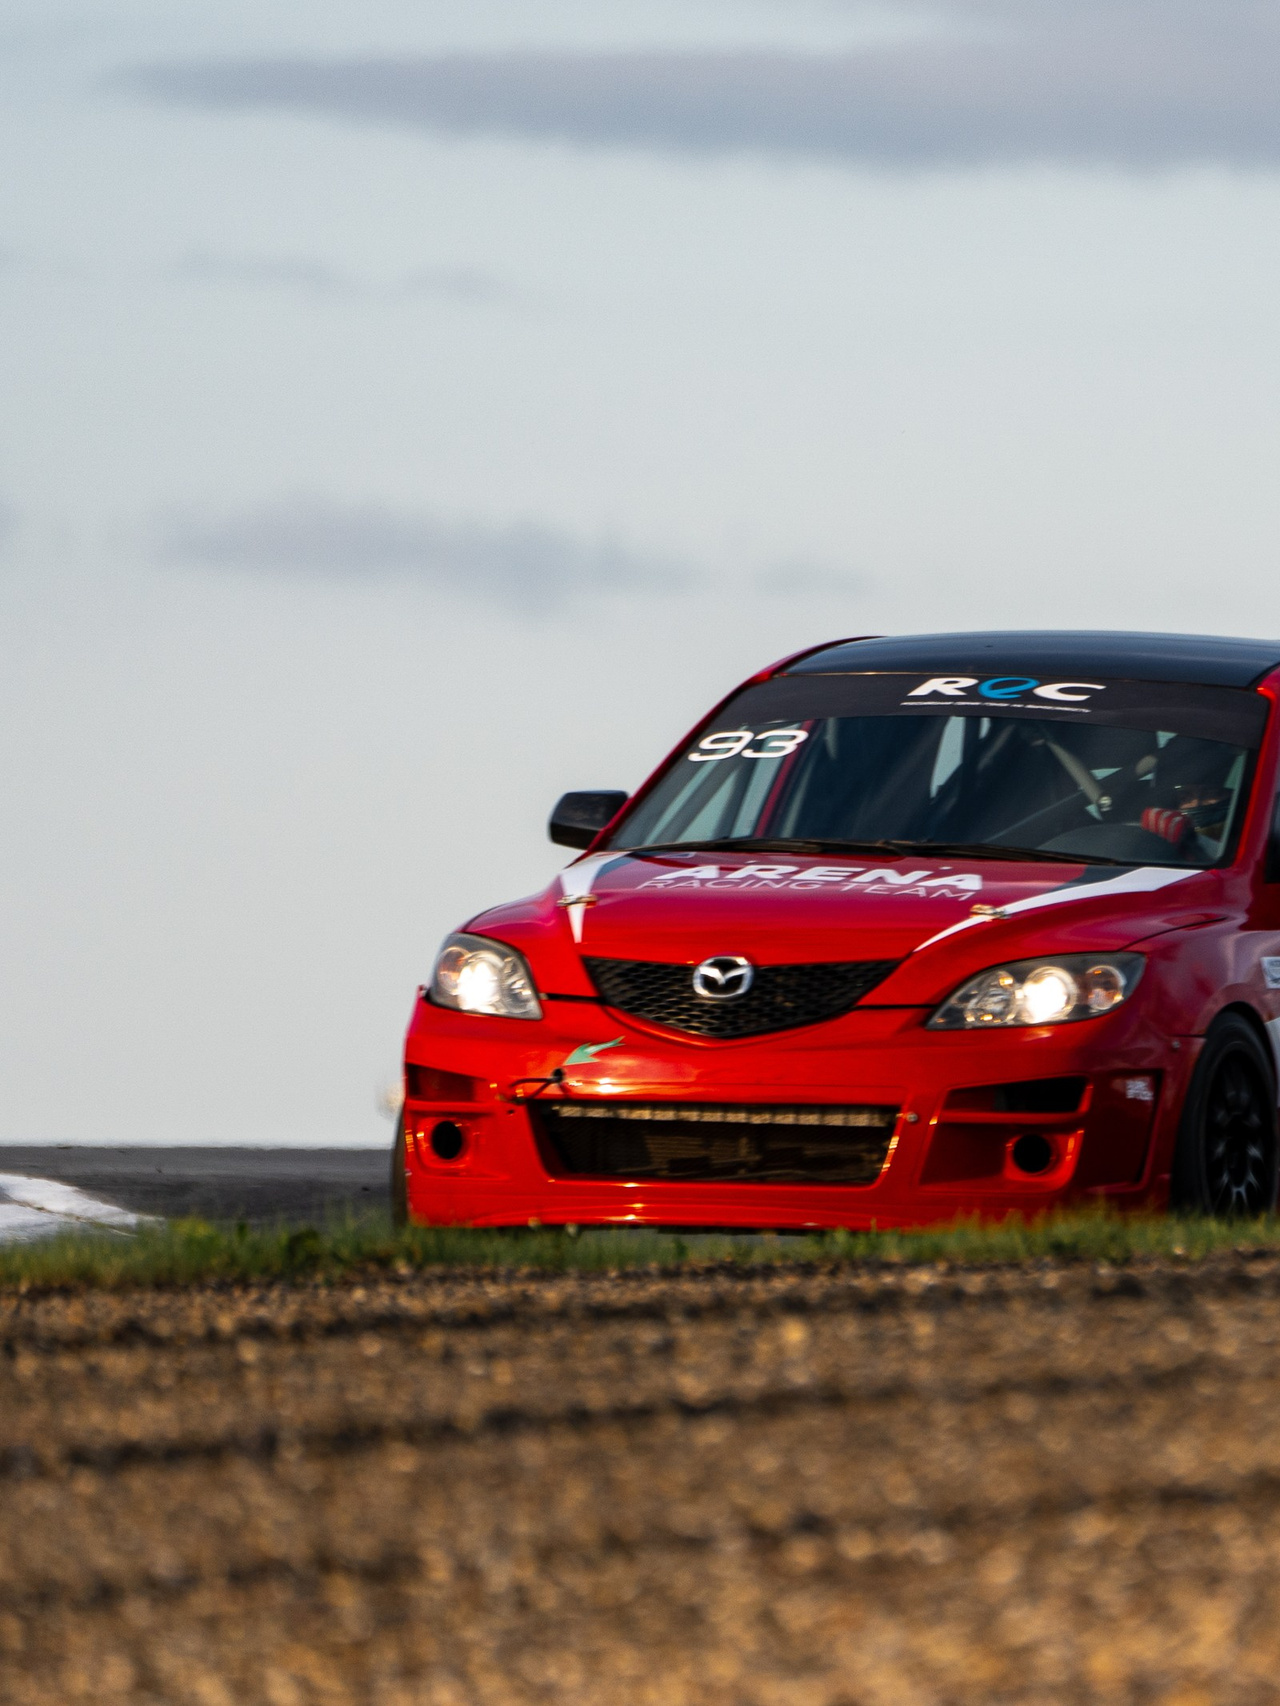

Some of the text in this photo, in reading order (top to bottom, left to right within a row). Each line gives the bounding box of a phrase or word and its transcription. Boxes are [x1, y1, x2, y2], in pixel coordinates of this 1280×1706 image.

[687, 730, 809, 762] 93
[653, 865, 983, 890] ARENA
[634, 879, 977, 902] RACING TEAM
